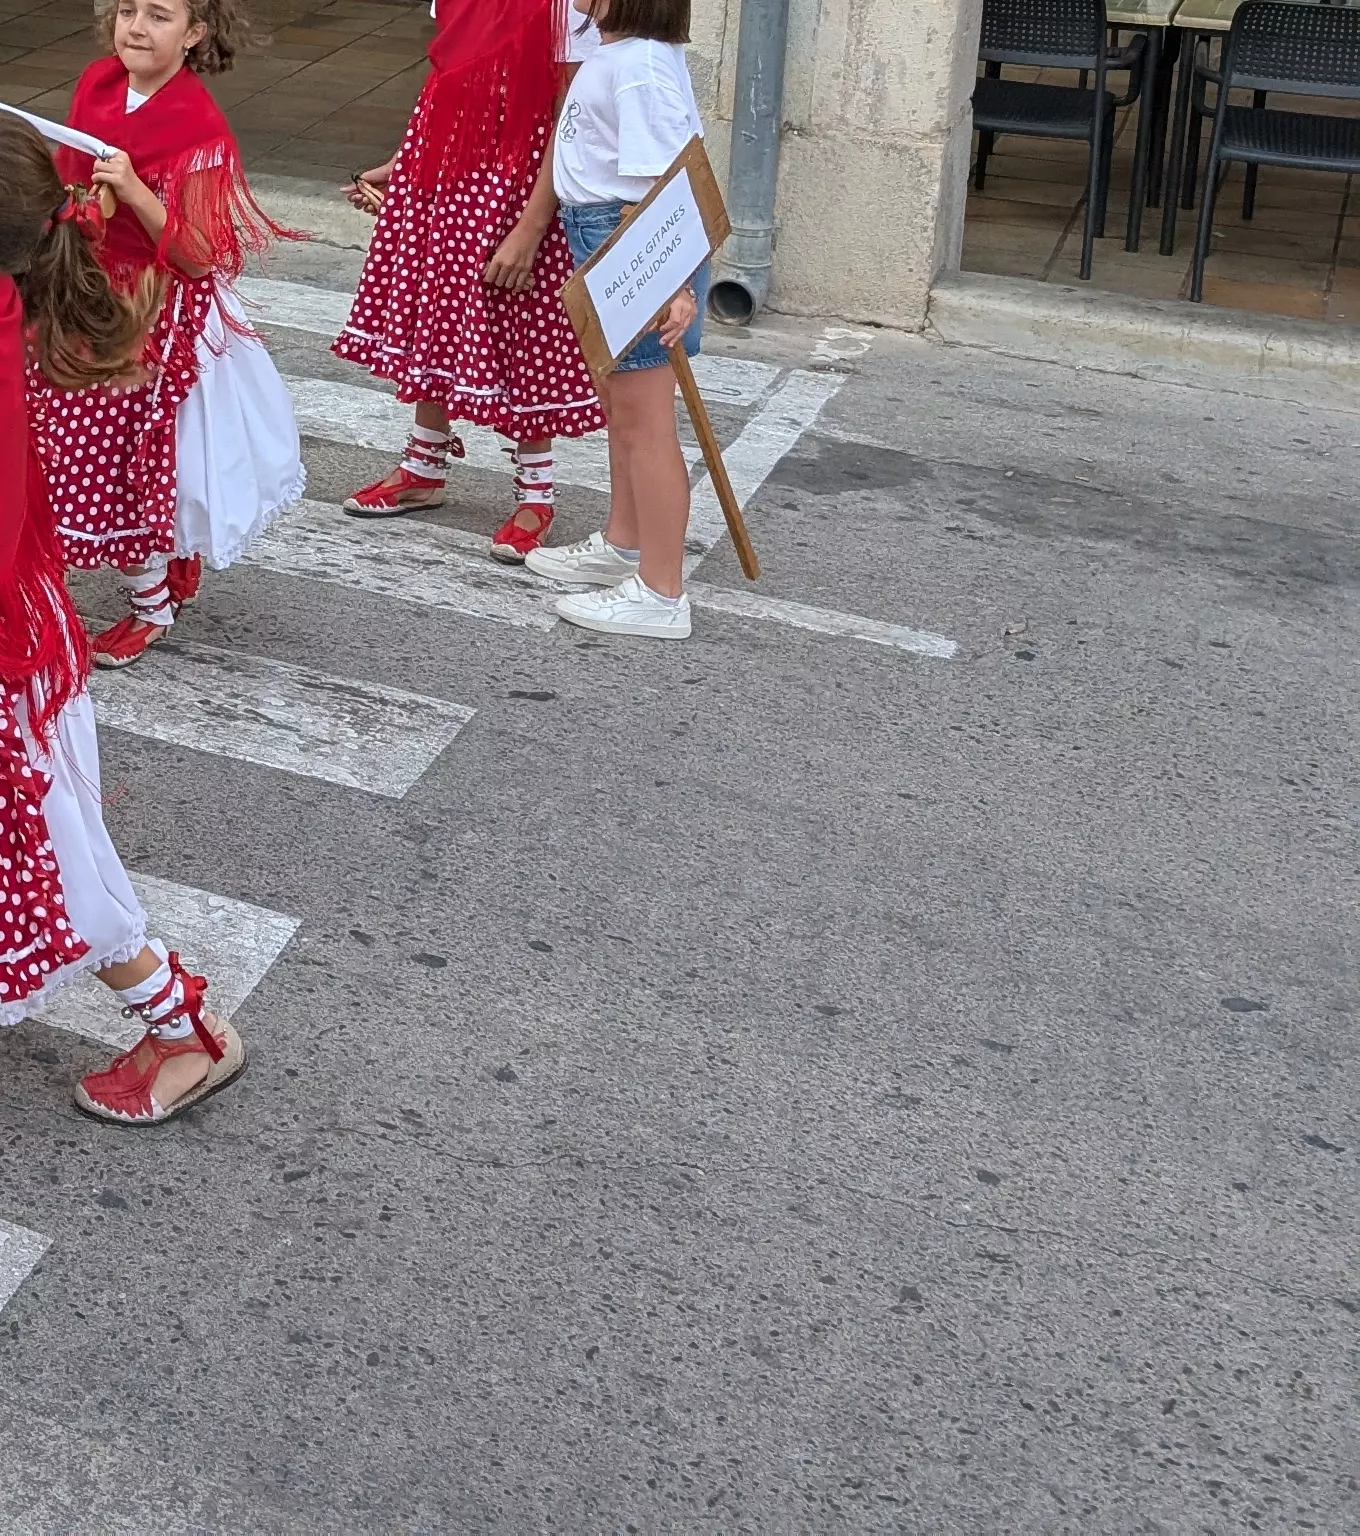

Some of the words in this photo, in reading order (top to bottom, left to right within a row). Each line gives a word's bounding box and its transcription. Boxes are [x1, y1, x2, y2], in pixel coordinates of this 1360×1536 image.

[604, 270, 630, 300] BALL
[630, 251, 645, 272] DE
[645, 204, 685, 255] GITANES
[621, 287, 636, 307] DE
[636, 233, 682, 291] RIUDOMS
